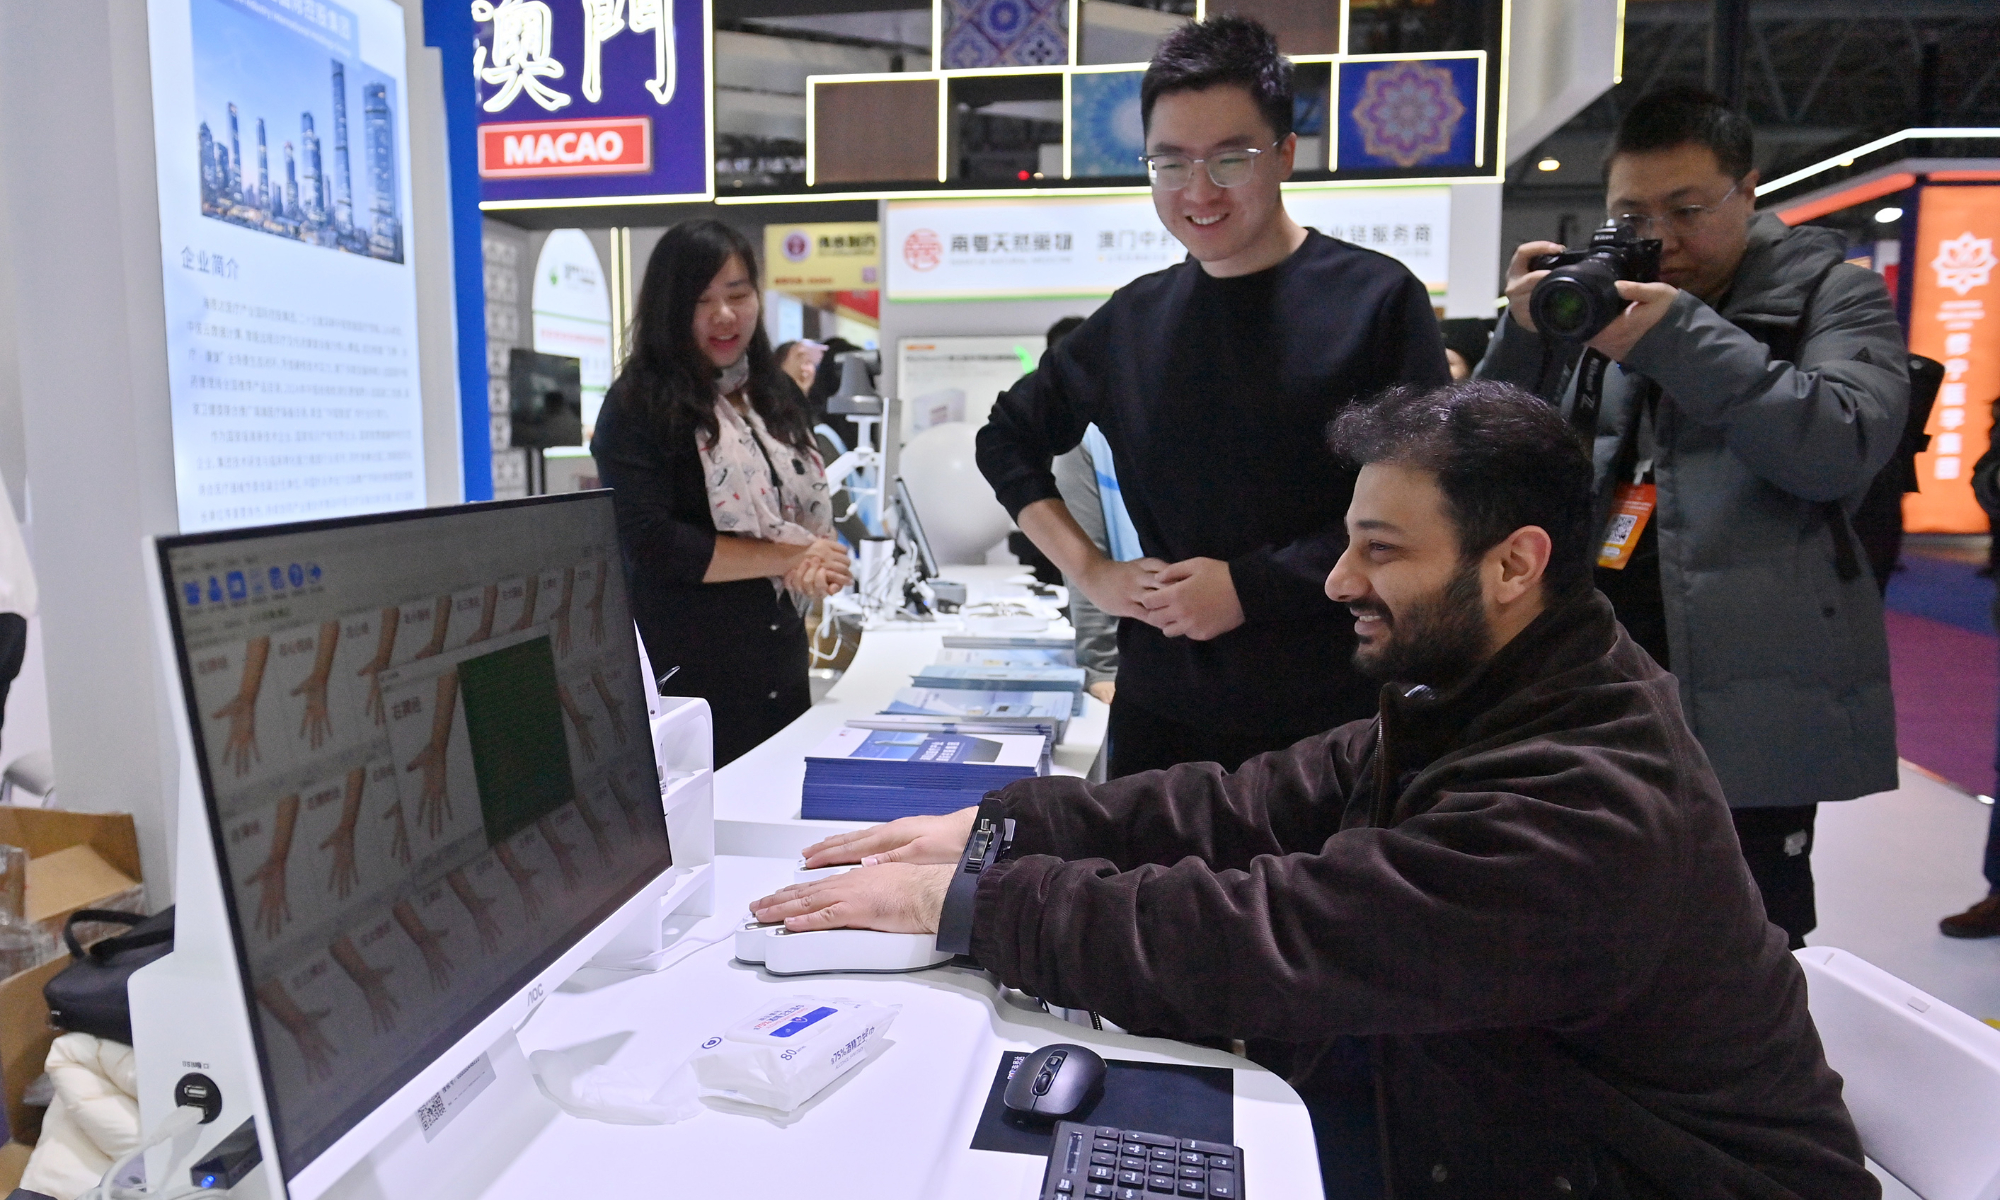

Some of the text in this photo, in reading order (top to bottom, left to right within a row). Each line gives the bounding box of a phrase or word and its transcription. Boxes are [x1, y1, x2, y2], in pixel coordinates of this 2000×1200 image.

[471, 0, 677, 113] 澳門
[503, 130, 624, 166] MACAO
[180, 245, 241, 280] 企业简介
[1579, 357, 1600, 410] Nikon Z
[527, 983, 544, 1007] AOC
[780, 1048, 798, 1061] 80
